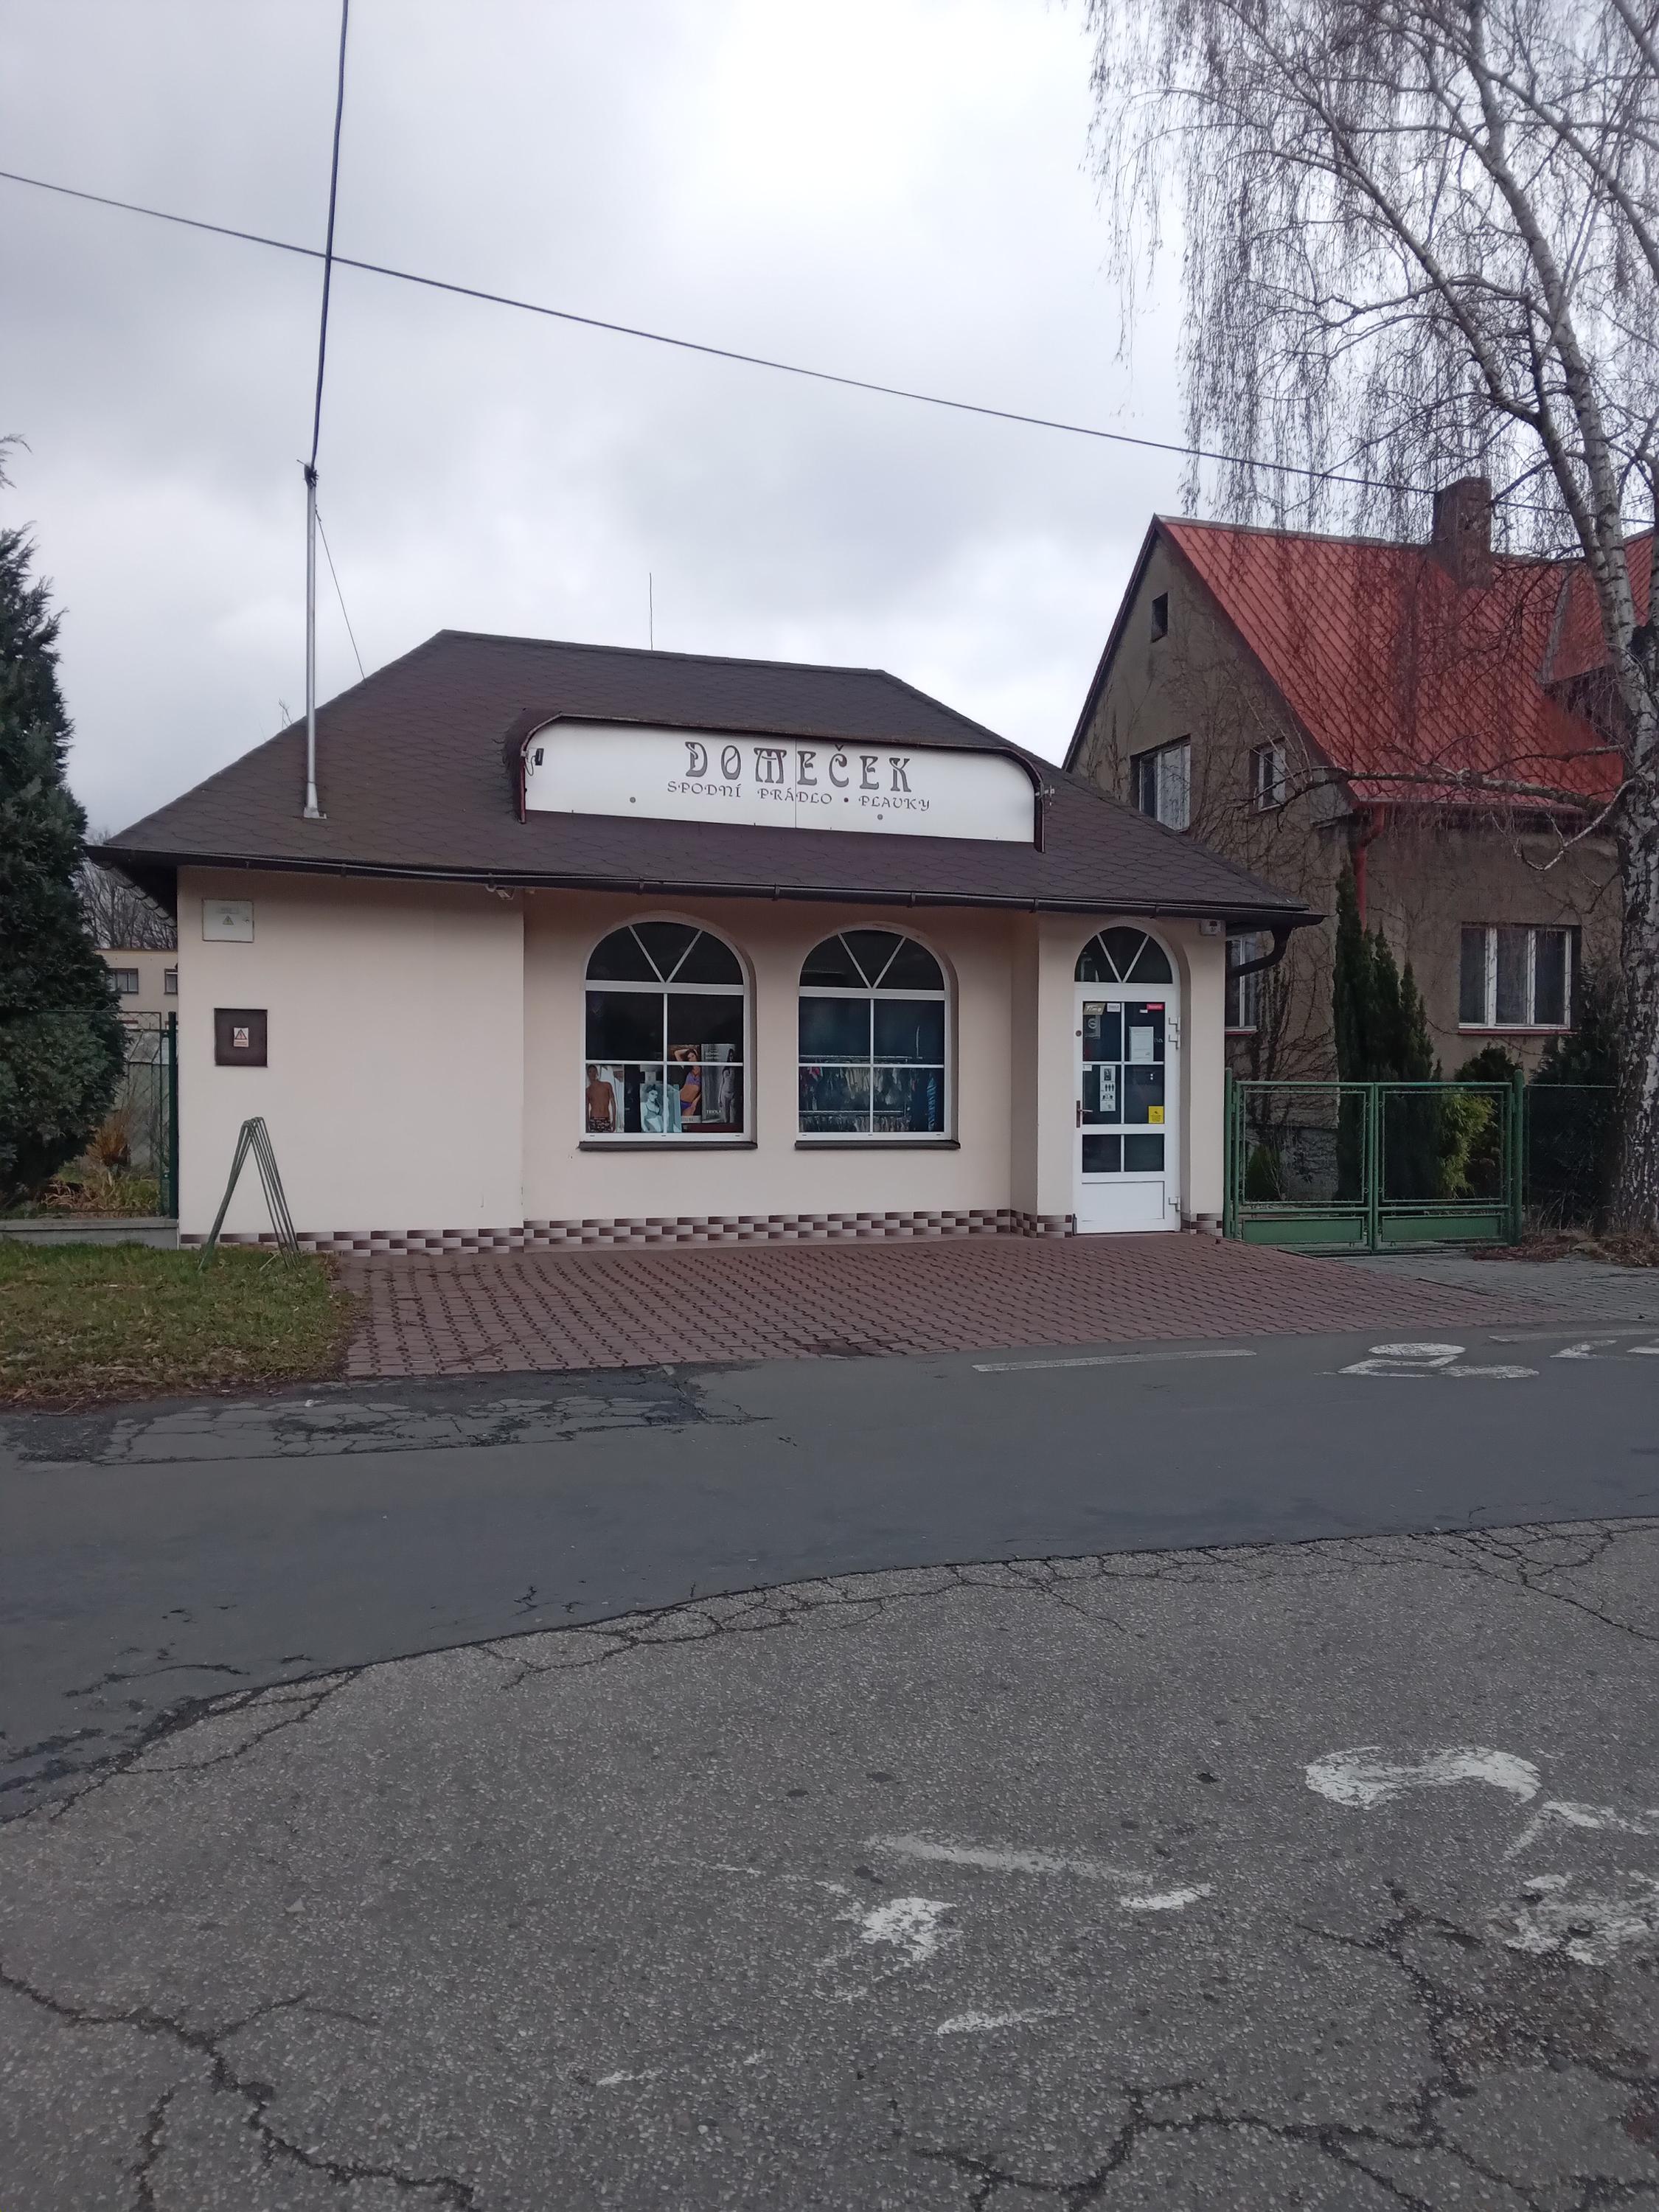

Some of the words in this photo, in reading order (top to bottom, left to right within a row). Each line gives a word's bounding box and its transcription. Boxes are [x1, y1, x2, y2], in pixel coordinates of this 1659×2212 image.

[685, 741, 911, 792] DOMEČEK
[667, 781, 742, 798] SPODNÍ
[757, 787, 832, 804] PRÁDLO
